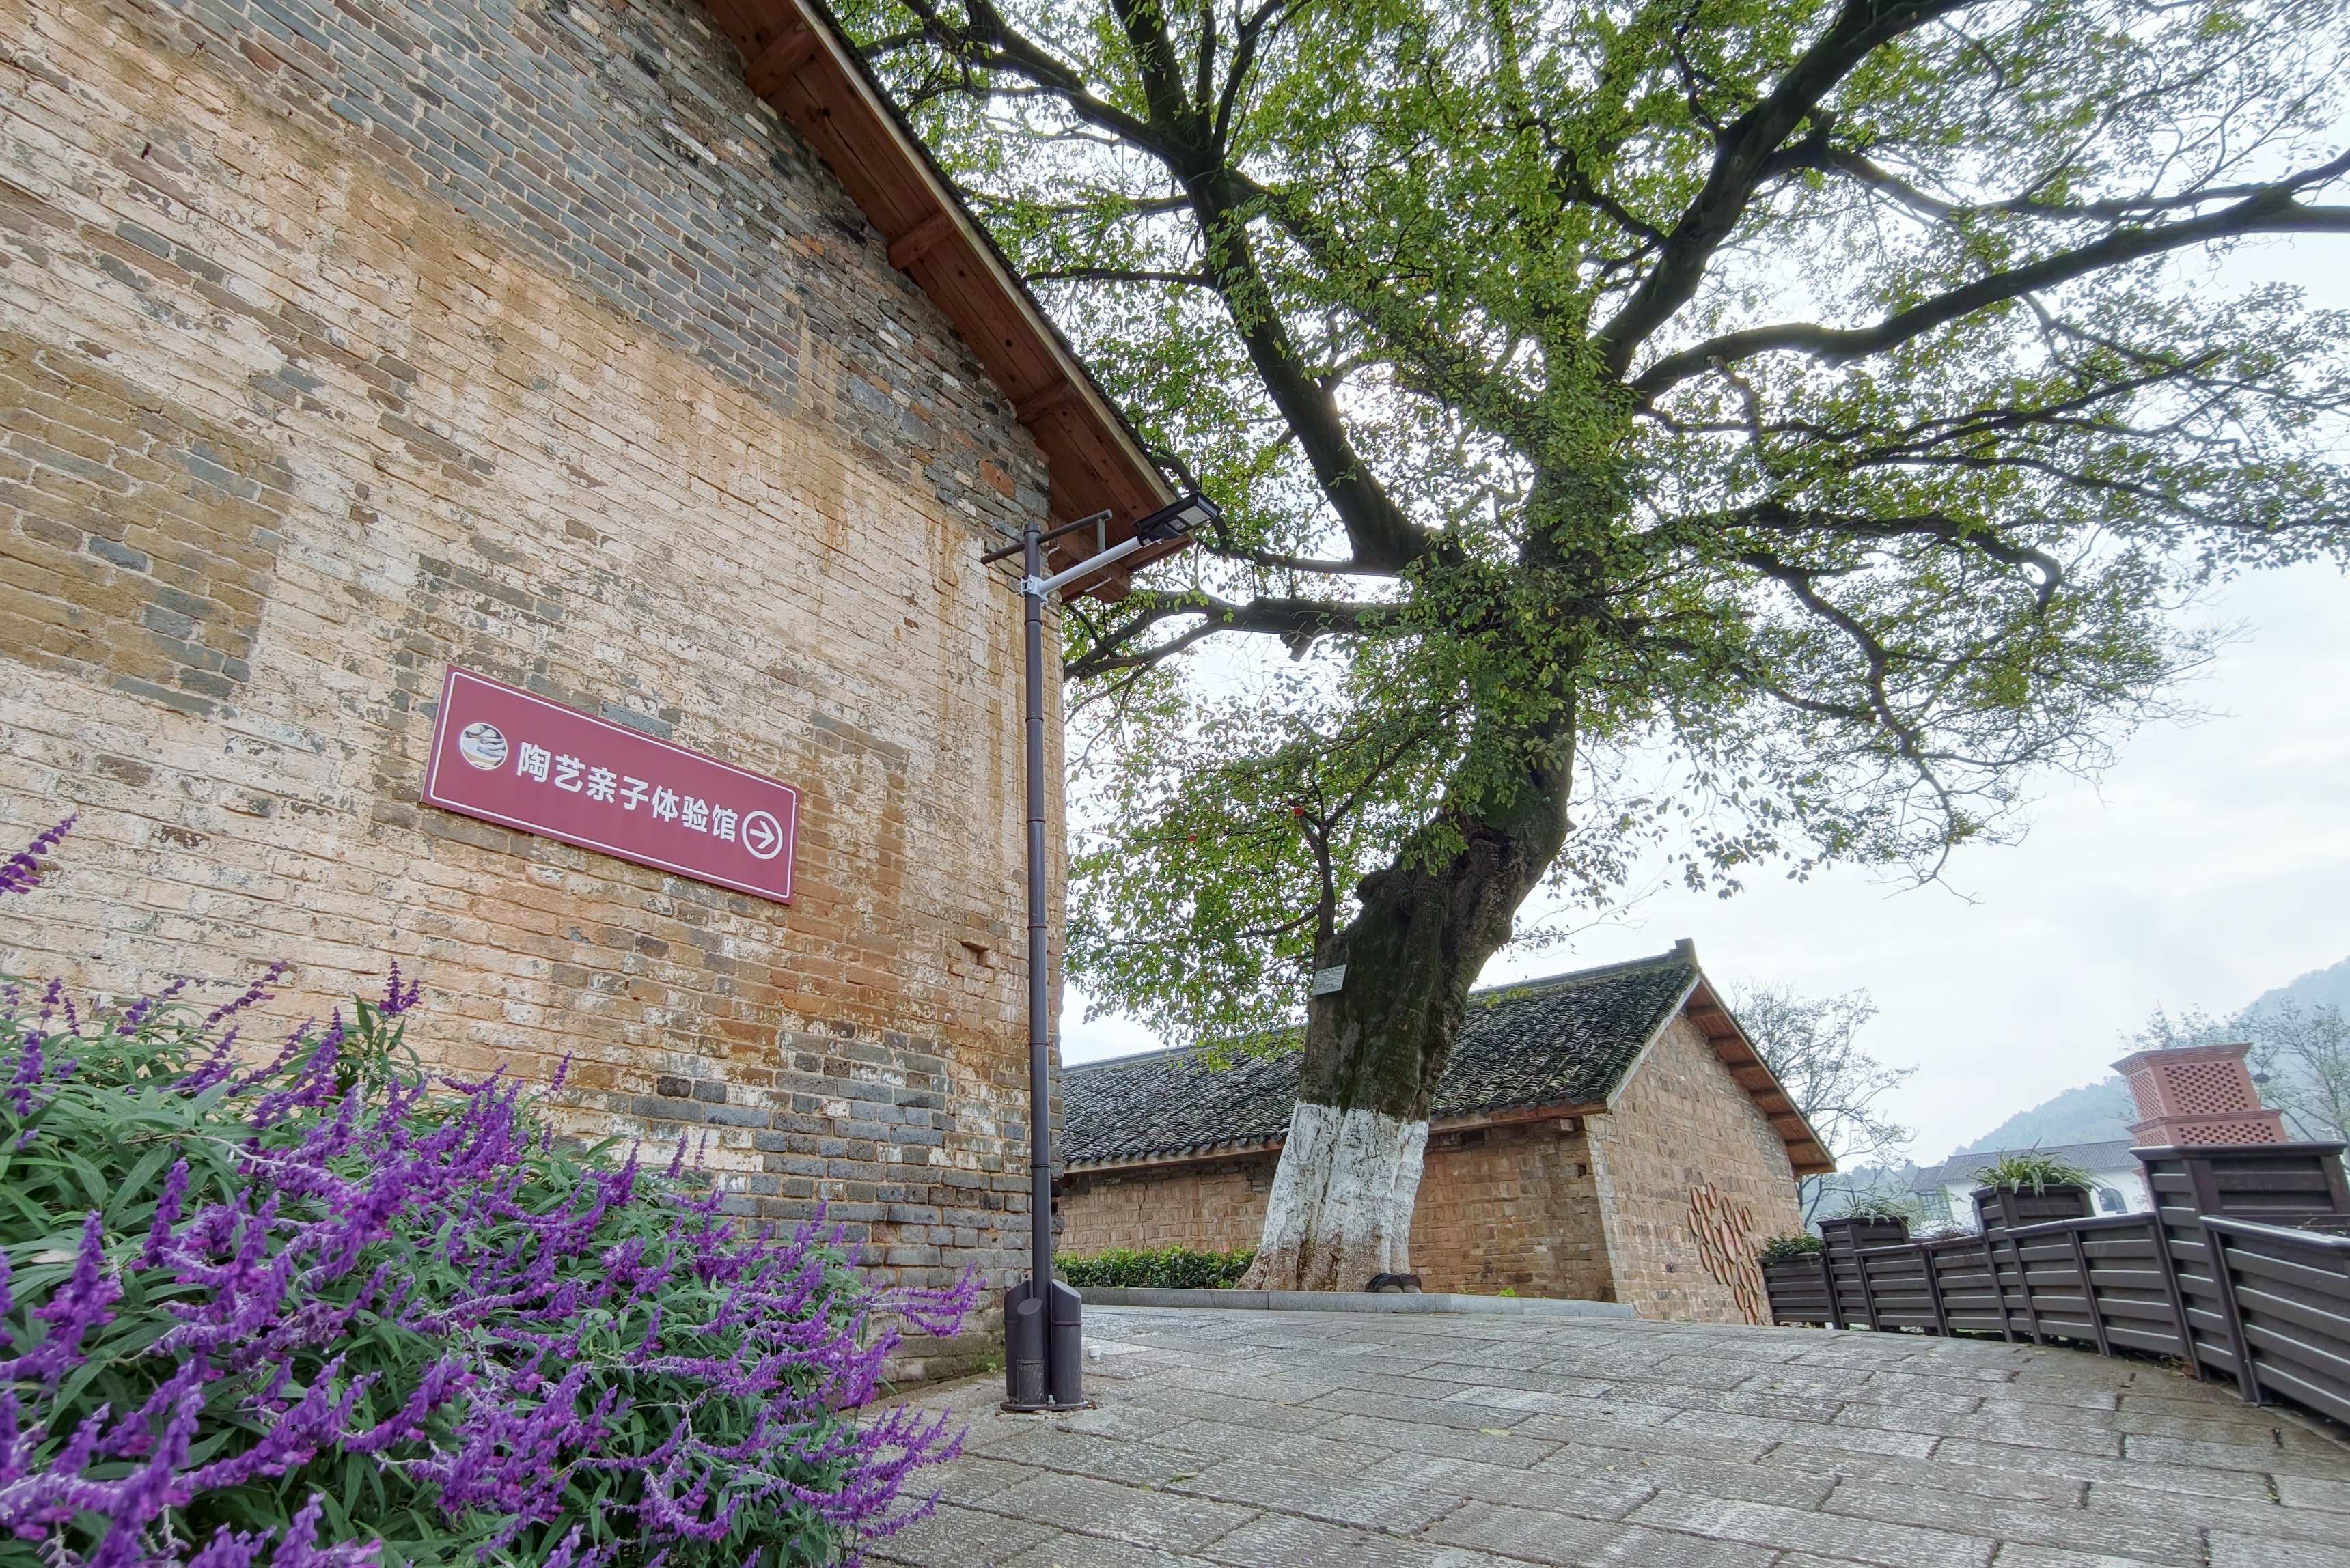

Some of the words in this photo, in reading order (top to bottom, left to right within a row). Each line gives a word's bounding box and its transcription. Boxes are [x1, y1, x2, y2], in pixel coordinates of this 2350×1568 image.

[516, 742, 738, 842] 陶艺亲子体验馆
